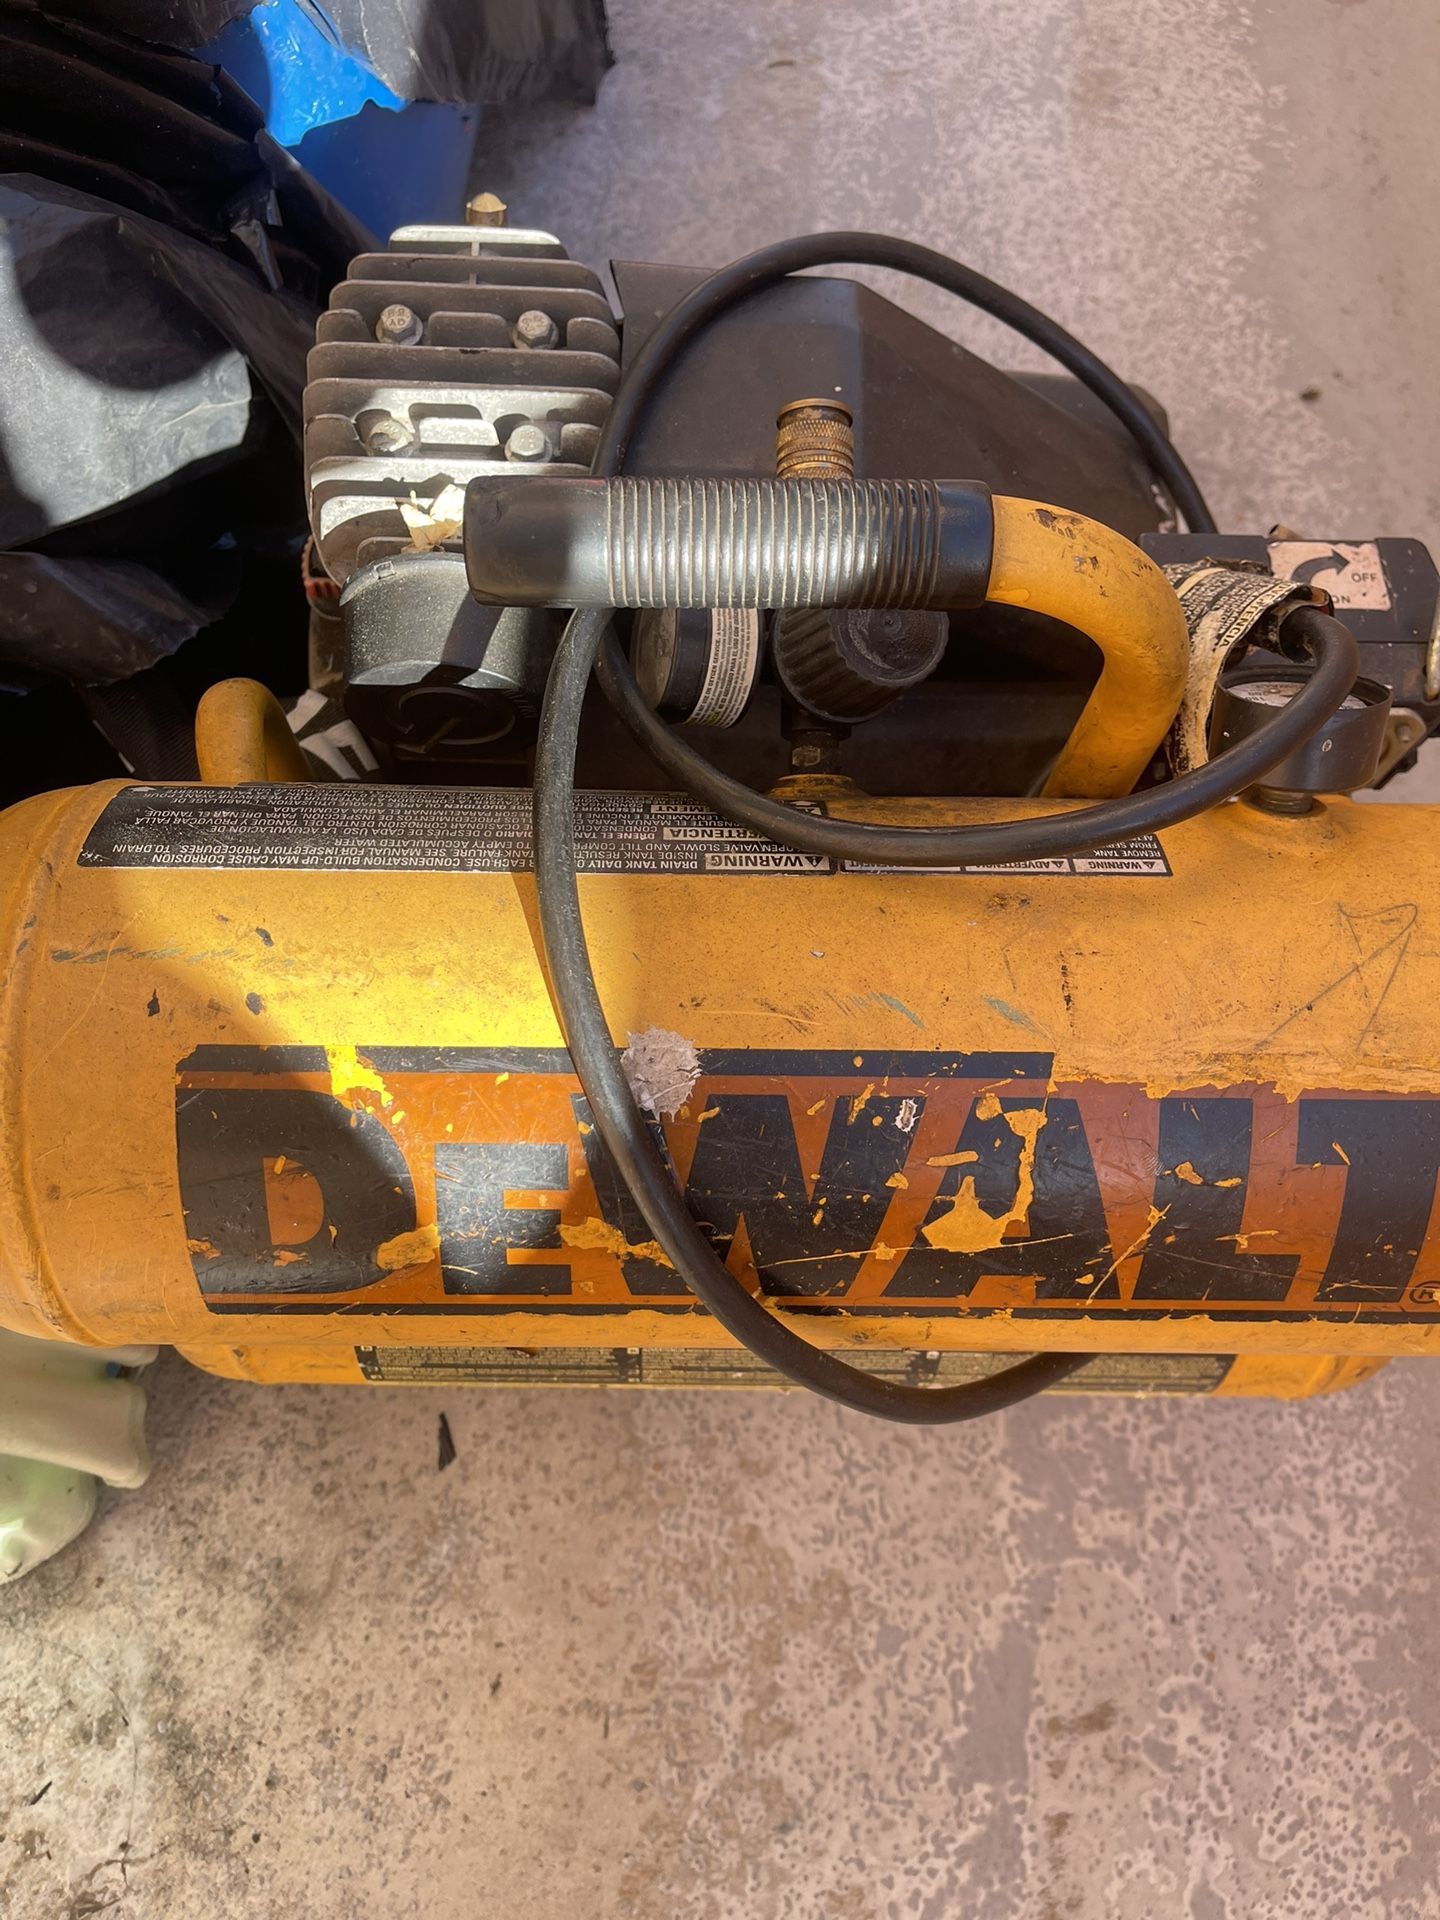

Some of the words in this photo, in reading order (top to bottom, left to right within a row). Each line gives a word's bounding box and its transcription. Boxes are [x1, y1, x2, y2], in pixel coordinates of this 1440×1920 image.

[1351, 572, 1378, 584] OFF
[1331, 594, 1352, 604] ON
[396, 815, 501, 823] PROCEDIMIENTOS
[585, 812, 631, 820] INCLINE
[173, 817, 239, 825] PROVOCAR
[249, 818, 299, 826] TANQUE
[303, 819, 323, 827] DEL
[327, 820, 375, 828] DENTRO
[210, 825, 227, 833] DE
[322, 826, 338, 835] LA
[450, 822, 520, 831] OCASIONAR
[370, 827, 405, 836] CADA
[407, 828, 424, 836] DE
[601, 831, 614, 840] EL
[617, 831, 655, 841] DRENE
[379, 838, 470, 849] ACCUMULATED
[471, 840, 513, 849] EMPTY
[516, 841, 531, 849] TO
[619, 842, 643, 851] TILT
[645, 842, 672, 851] AND
[674, 843, 720, 852] SLOWLY
[723, 843, 760, 852] VALVE
[762, 844, 792, 852] OPEN
[112, 844, 154, 853] DRAIN
[155, 844, 170, 854] TO
[264, 846, 340, 856] INSPECTION
[340, 847, 364, 856] FOR
[368, 847, 422, 857] MANUAL
[424, 848, 447, 857] SEE
[1092, 849, 1119, 857] TANK
[503, 849, 535, 858] TANK
[573, 850, 620, 860] RESULTI
[624, 851, 655, 860] TANK
[658, 851, 698, 860] INSIDE
[1121, 849, 1162, 858] REMOVE
[152, 854, 225, 864] CORROSION
[227, 854, 269, 865] CAUSE
[270, 855, 299, 865] MAY
[301, 855, 361, 866] BUILD-UP
[364, 856, 461, 867] CONDENSATION
[494, 858, 526, 868] EACH
[710, 855, 804, 868] WARNING
[588, 859, 622, 869] DAILY
[625, 859, 657, 869] TANK
[660, 860, 698, 870] DRAIN
[1088, 860, 1142, 870] WARNING
